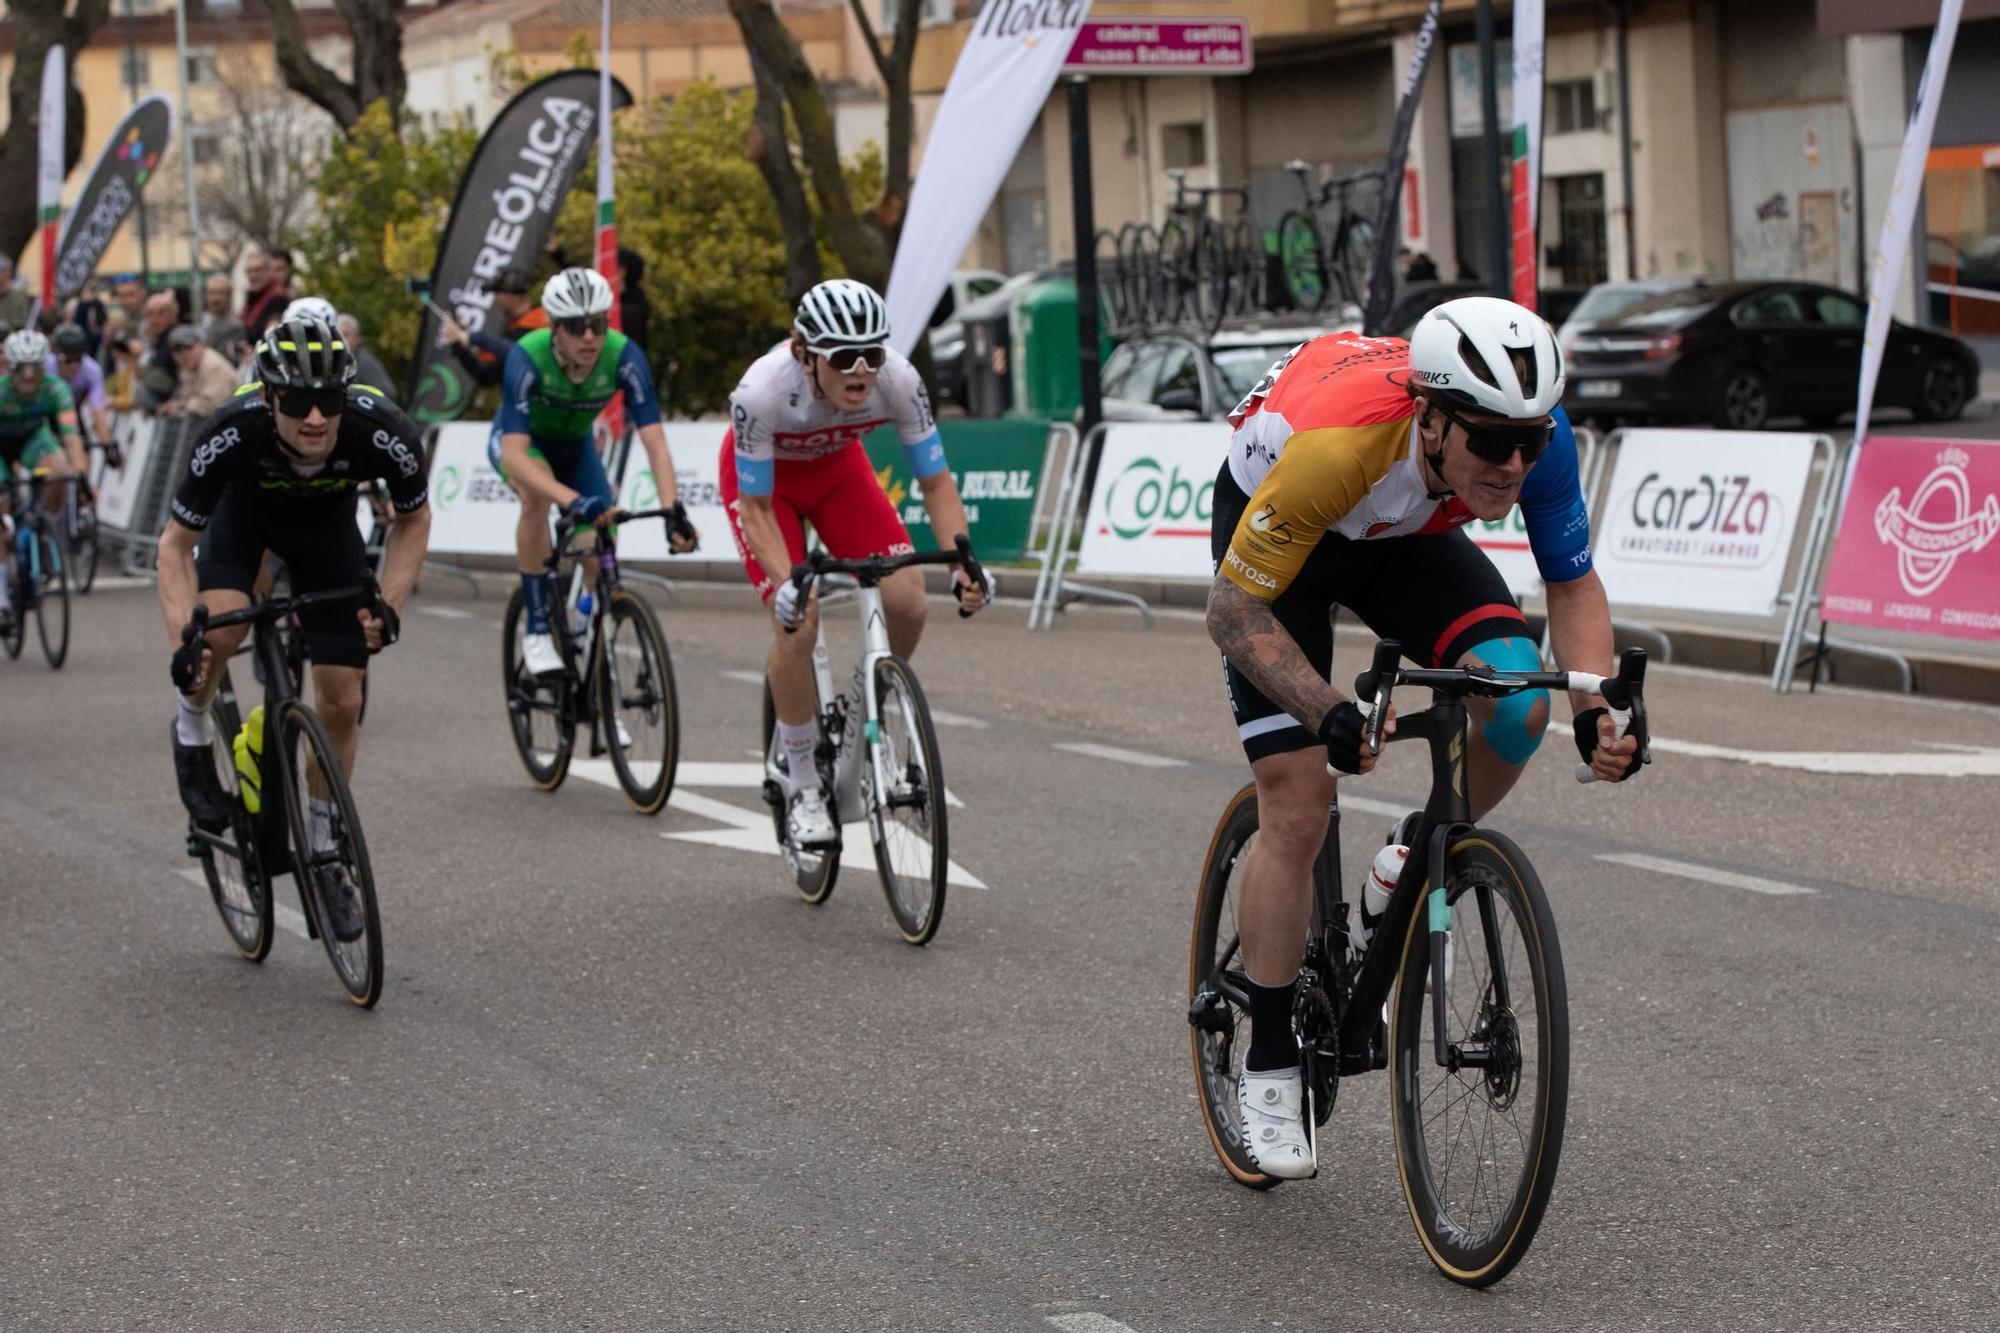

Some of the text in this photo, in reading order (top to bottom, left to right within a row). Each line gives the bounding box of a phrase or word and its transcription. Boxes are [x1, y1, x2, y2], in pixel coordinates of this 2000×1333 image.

[1096, 25, 1241, 43] catedral castillo
[1083, 46, 1241, 64] museo Baltasar Lobo
[963, 471, 1034, 499] RURAL
